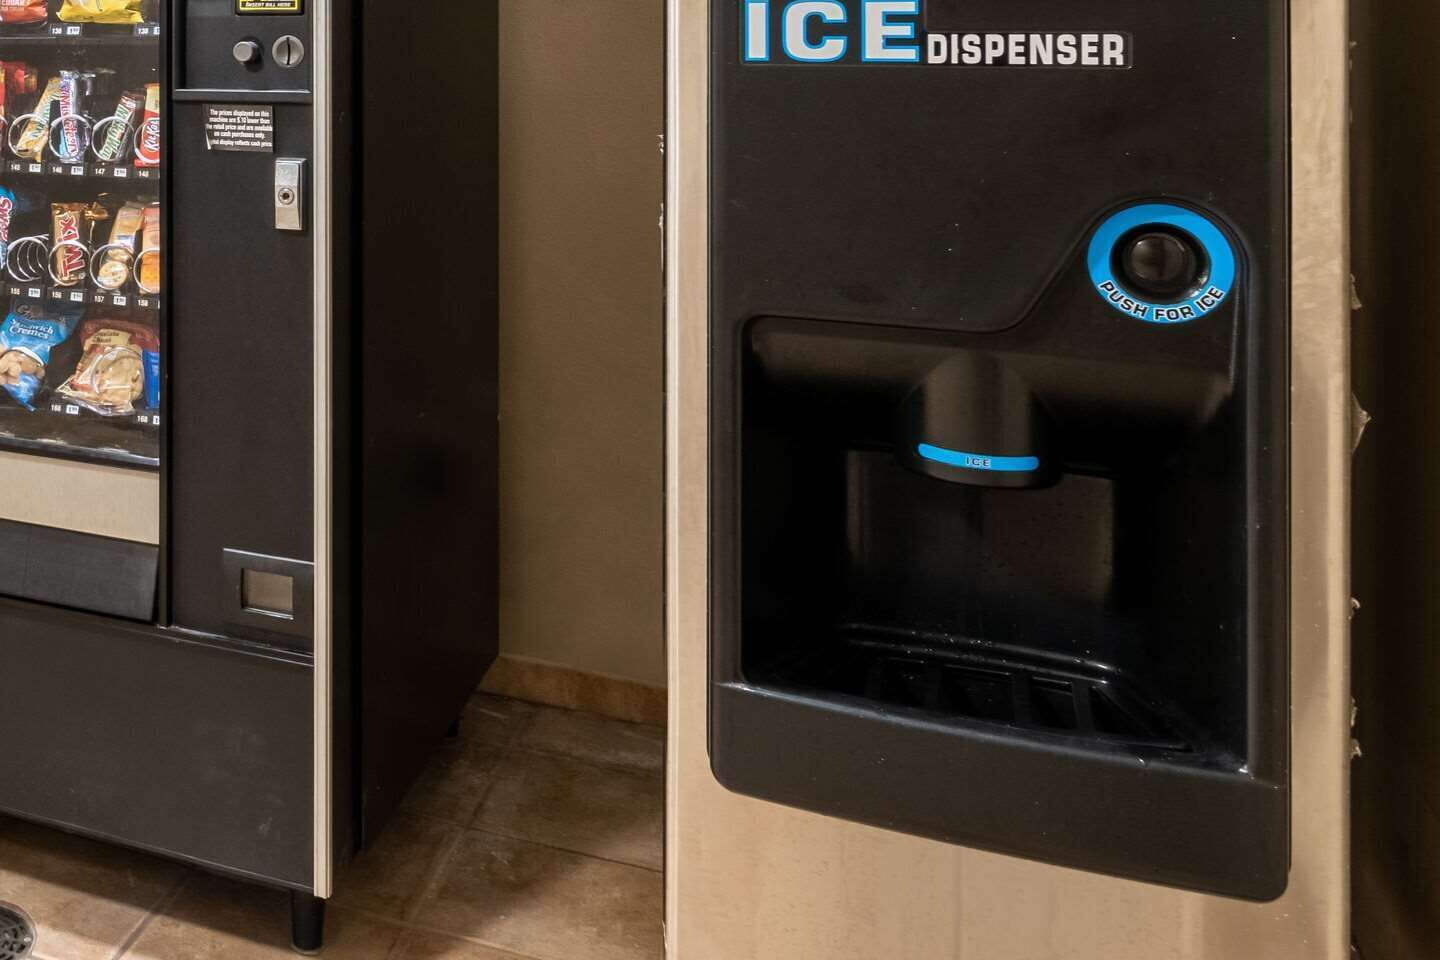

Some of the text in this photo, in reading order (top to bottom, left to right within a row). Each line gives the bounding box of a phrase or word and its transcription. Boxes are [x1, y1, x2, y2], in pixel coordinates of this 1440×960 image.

[926, 33, 1125, 66] DISPENSER
[1099, 280, 1224, 321] PUSH FOR ICE
[9, 327, 49, 340] Cremes
[965, 457, 991, 467] ICE
